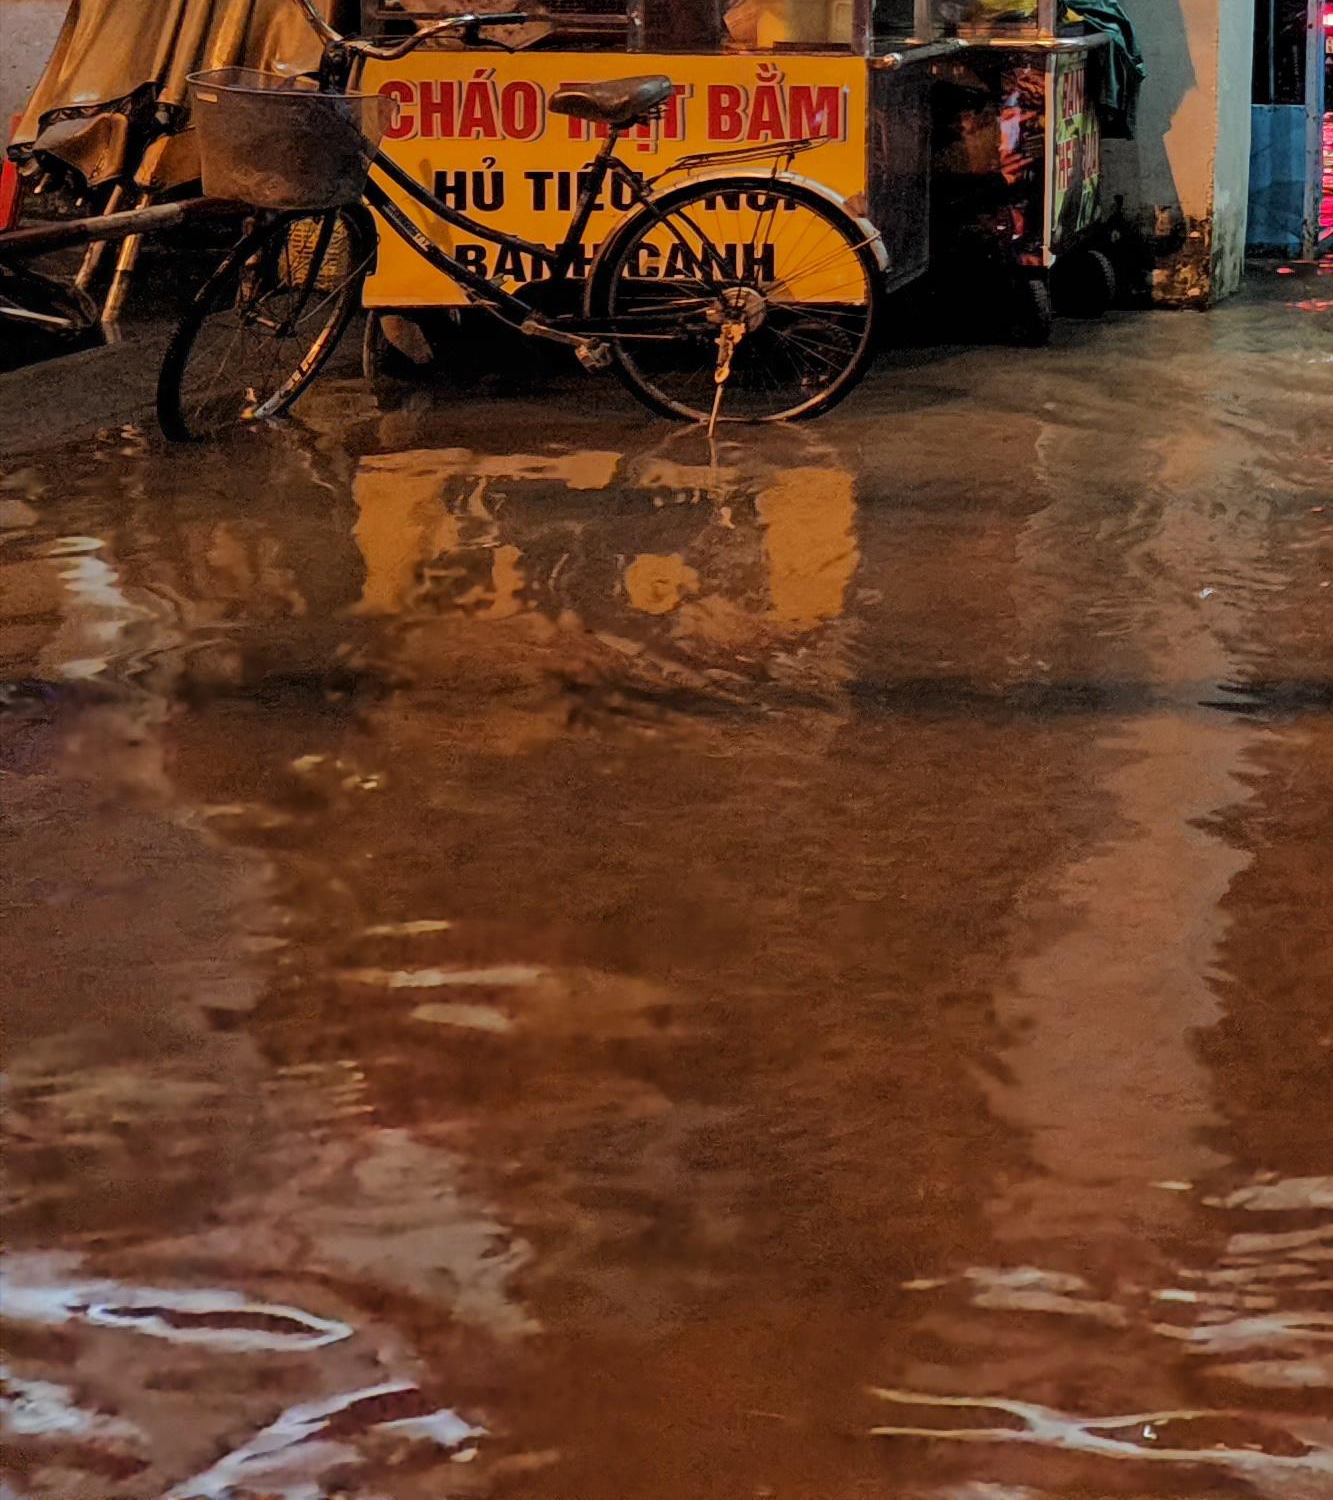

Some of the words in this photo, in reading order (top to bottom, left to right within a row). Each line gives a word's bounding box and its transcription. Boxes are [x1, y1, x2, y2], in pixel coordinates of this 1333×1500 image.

[377, 68, 543, 141] CHÁO
[707, 62, 846, 142] BẰM
[433, 157, 505, 212] HỦ
